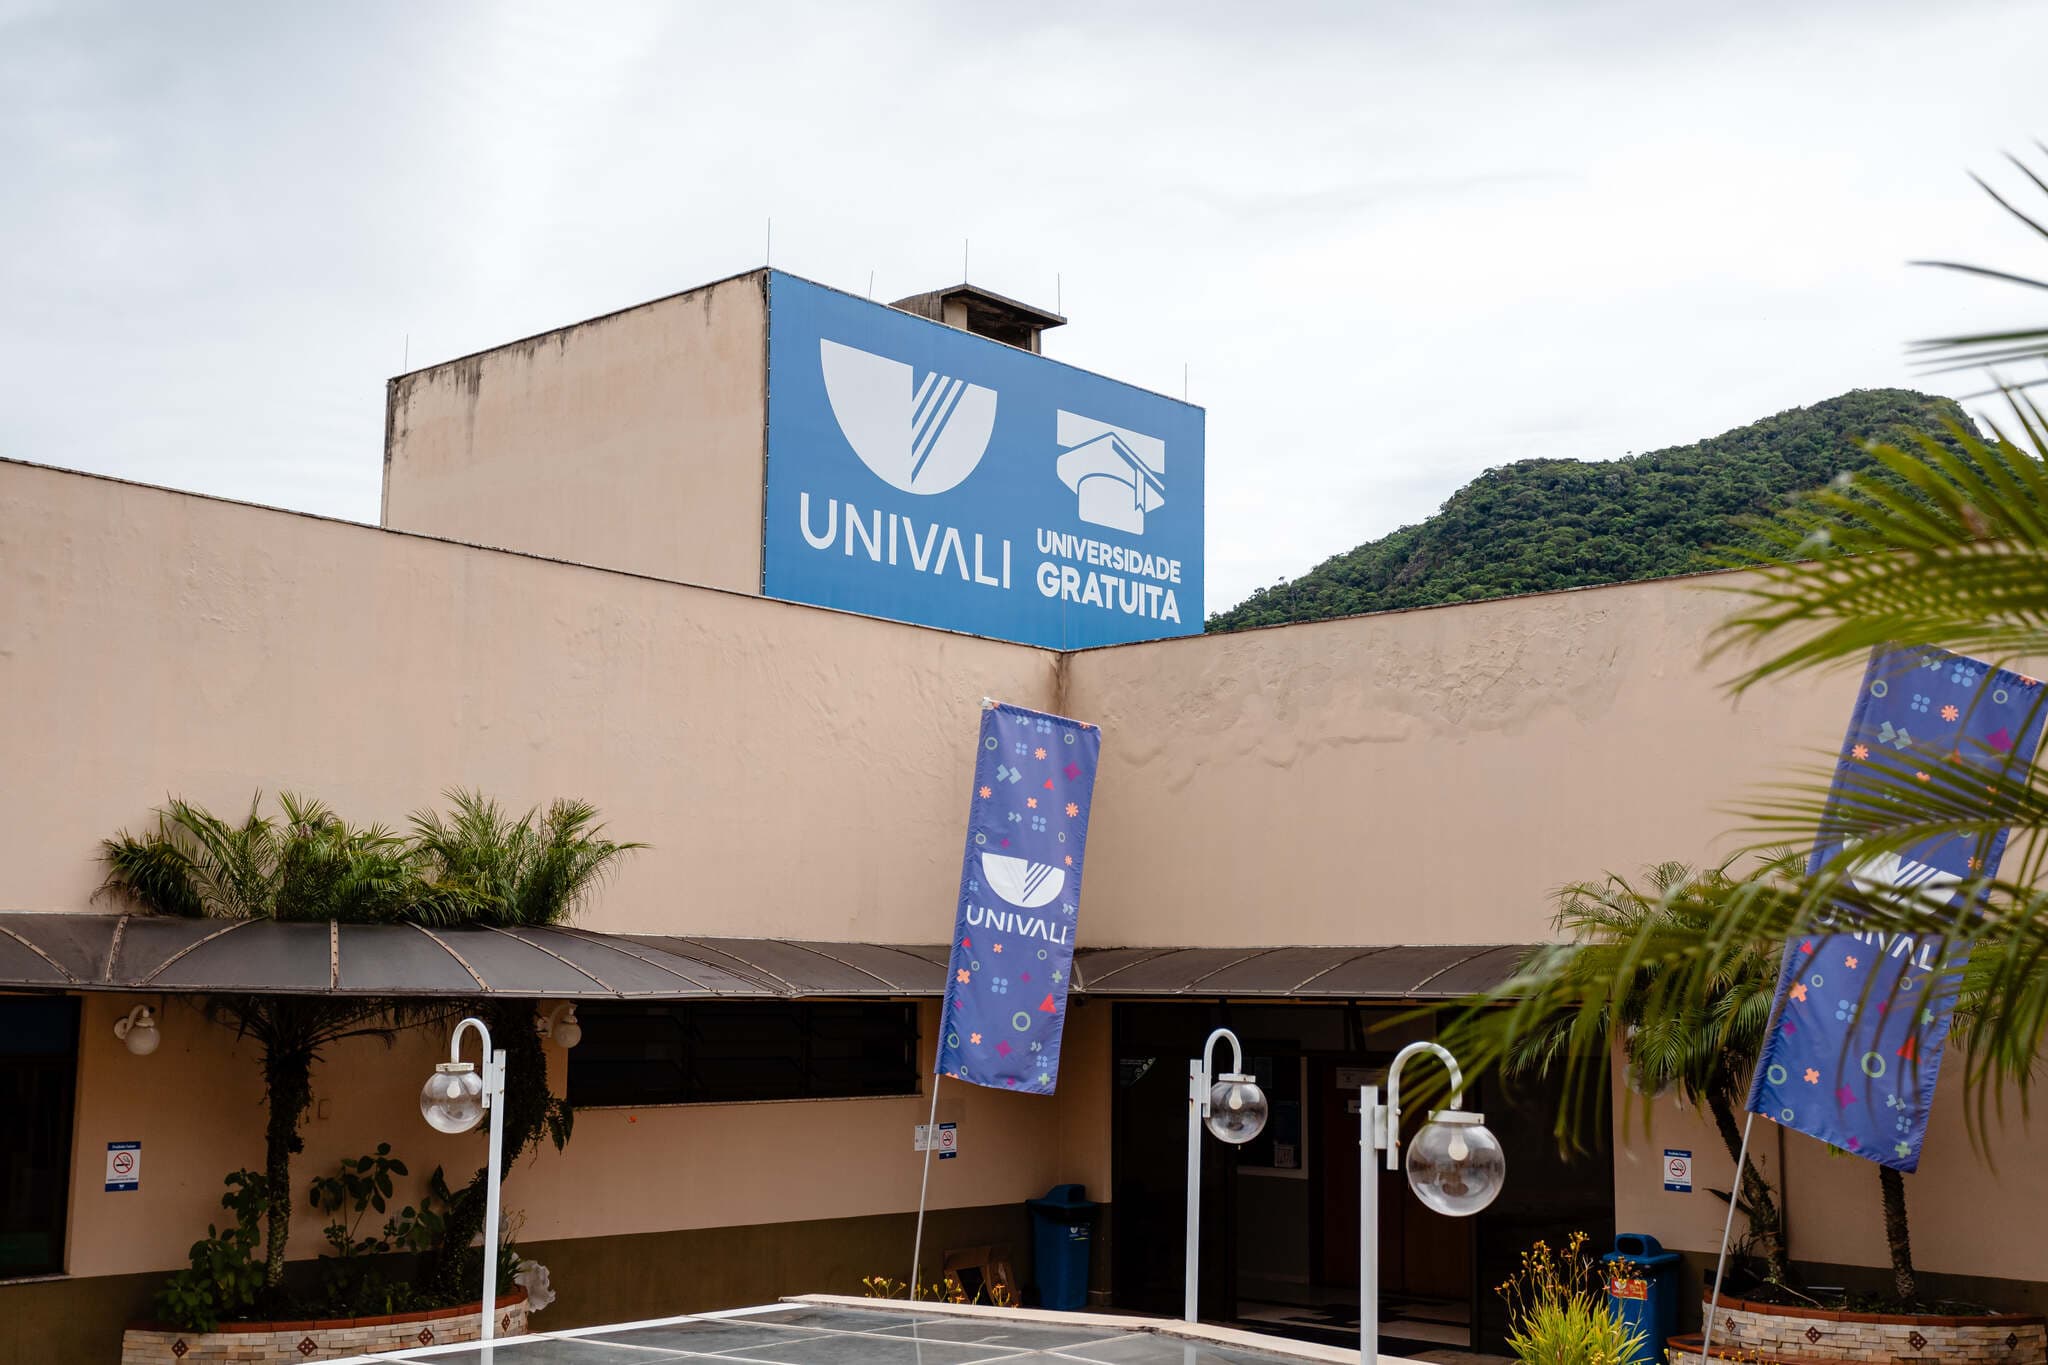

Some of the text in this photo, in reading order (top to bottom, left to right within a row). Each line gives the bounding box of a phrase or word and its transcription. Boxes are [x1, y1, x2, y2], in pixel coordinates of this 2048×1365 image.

[800, 492, 1011, 589] UNIVALI
[1037, 528, 1181, 584] UNIVERSIDADE
[1036, 562, 1181, 624] GRATUITA
[966, 904, 1068, 945] UNIVALI
